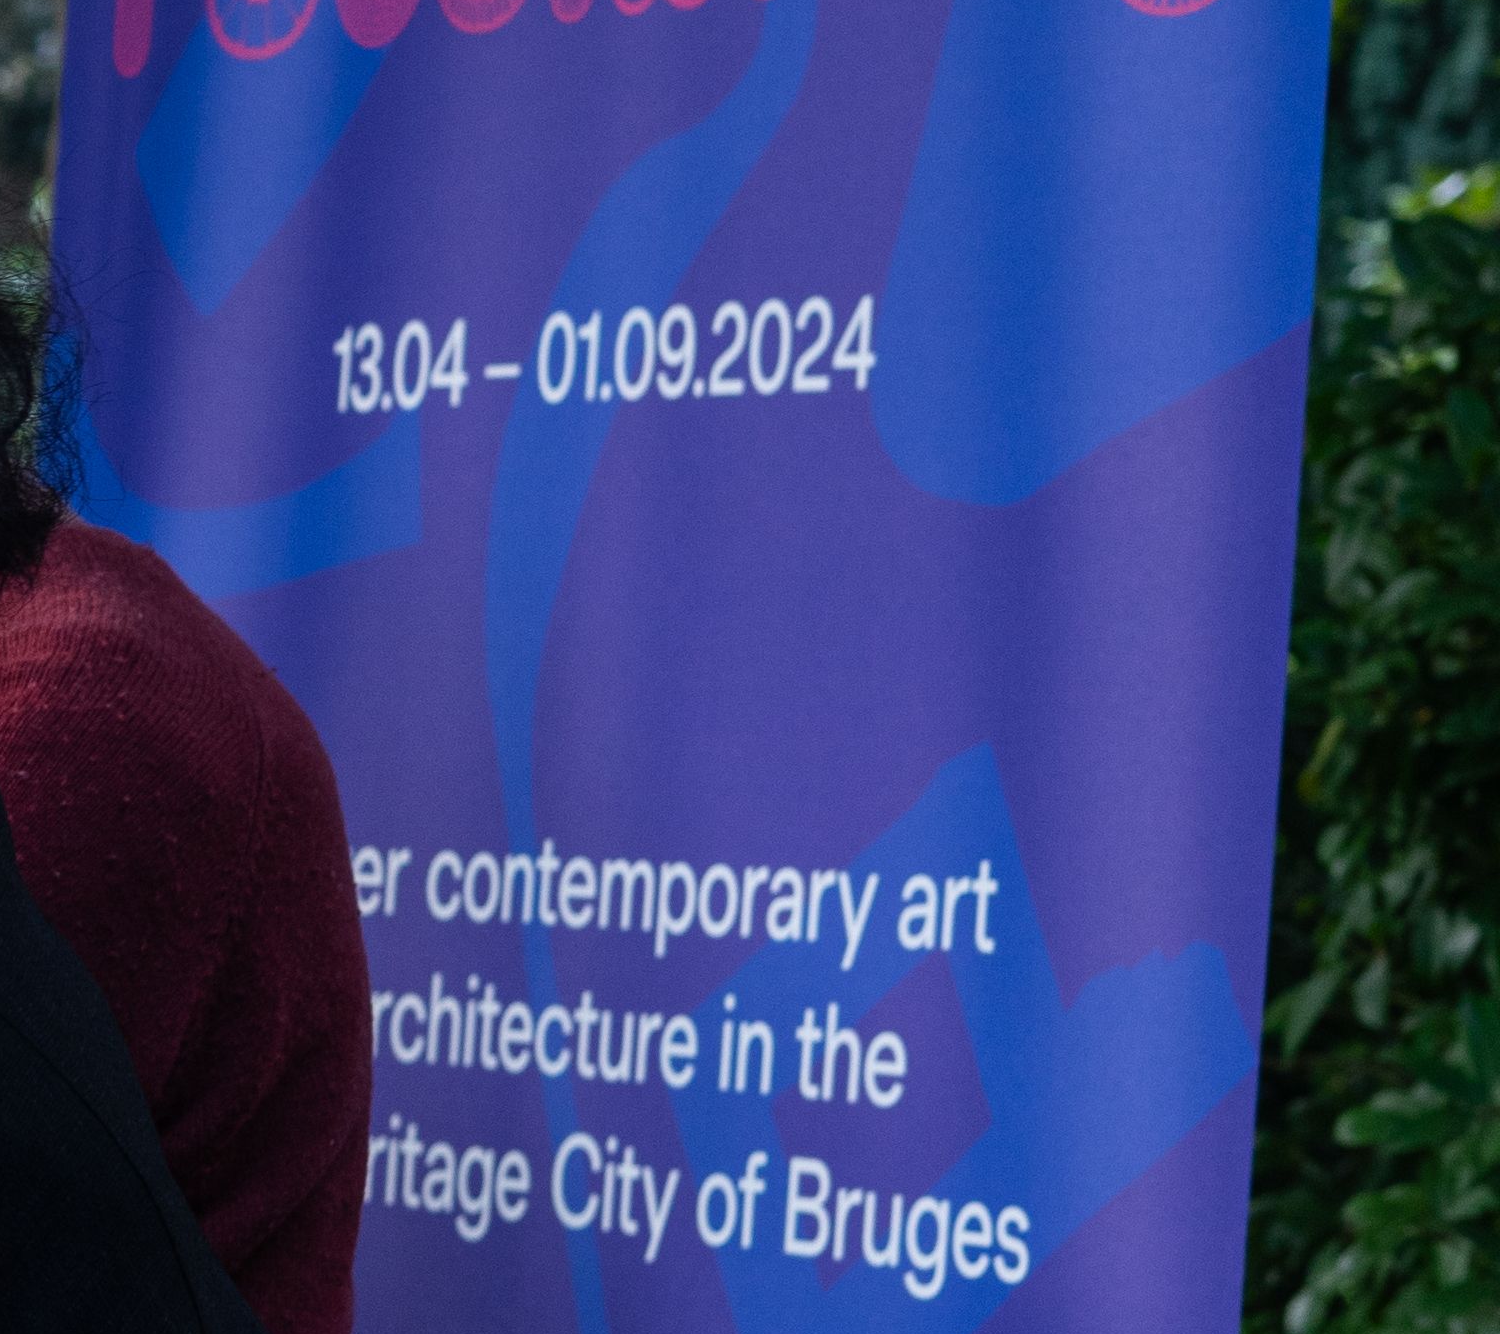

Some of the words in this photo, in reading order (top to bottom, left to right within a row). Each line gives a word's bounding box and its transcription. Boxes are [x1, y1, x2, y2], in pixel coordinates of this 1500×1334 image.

[332, 317, 469, 414] 13.04
[536, 294, 877, 405] 01.09.2024
[425, 838, 880, 971] contemporary
[897, 858, 999, 955] art
[716, 993, 775, 1095] in
[795, 1002, 908, 1109] the
[550, 1131, 681, 1265] City
[695, 1150, 769, 1251] of
[783, 1154, 1032, 1301] Bruges
